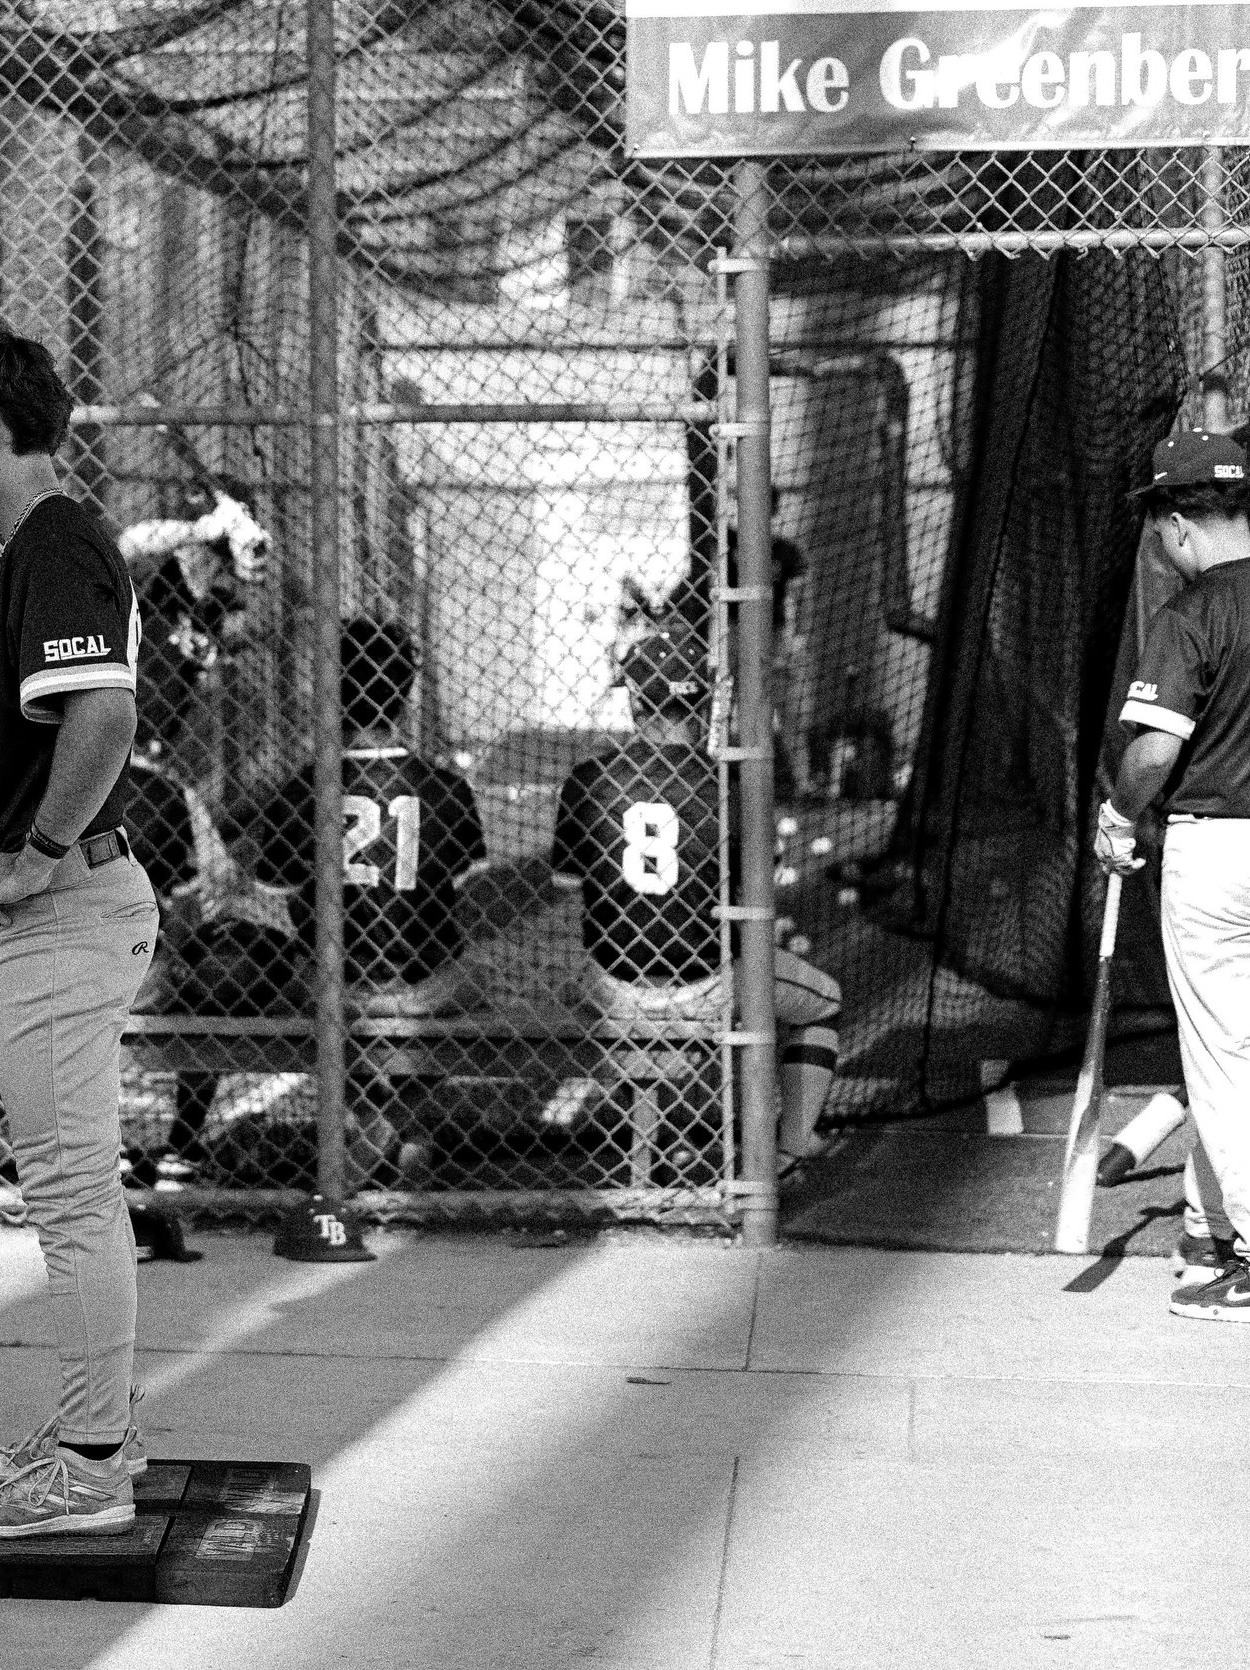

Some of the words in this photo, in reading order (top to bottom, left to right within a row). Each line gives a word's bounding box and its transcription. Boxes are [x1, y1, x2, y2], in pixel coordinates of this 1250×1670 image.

[668, 40, 850, 115] Mike
[43, 634, 112, 663] SOCAL
[343, 795, 421, 890] 21
[622, 801, 680, 896] 8
[313, 1214, 348, 1247] TB
